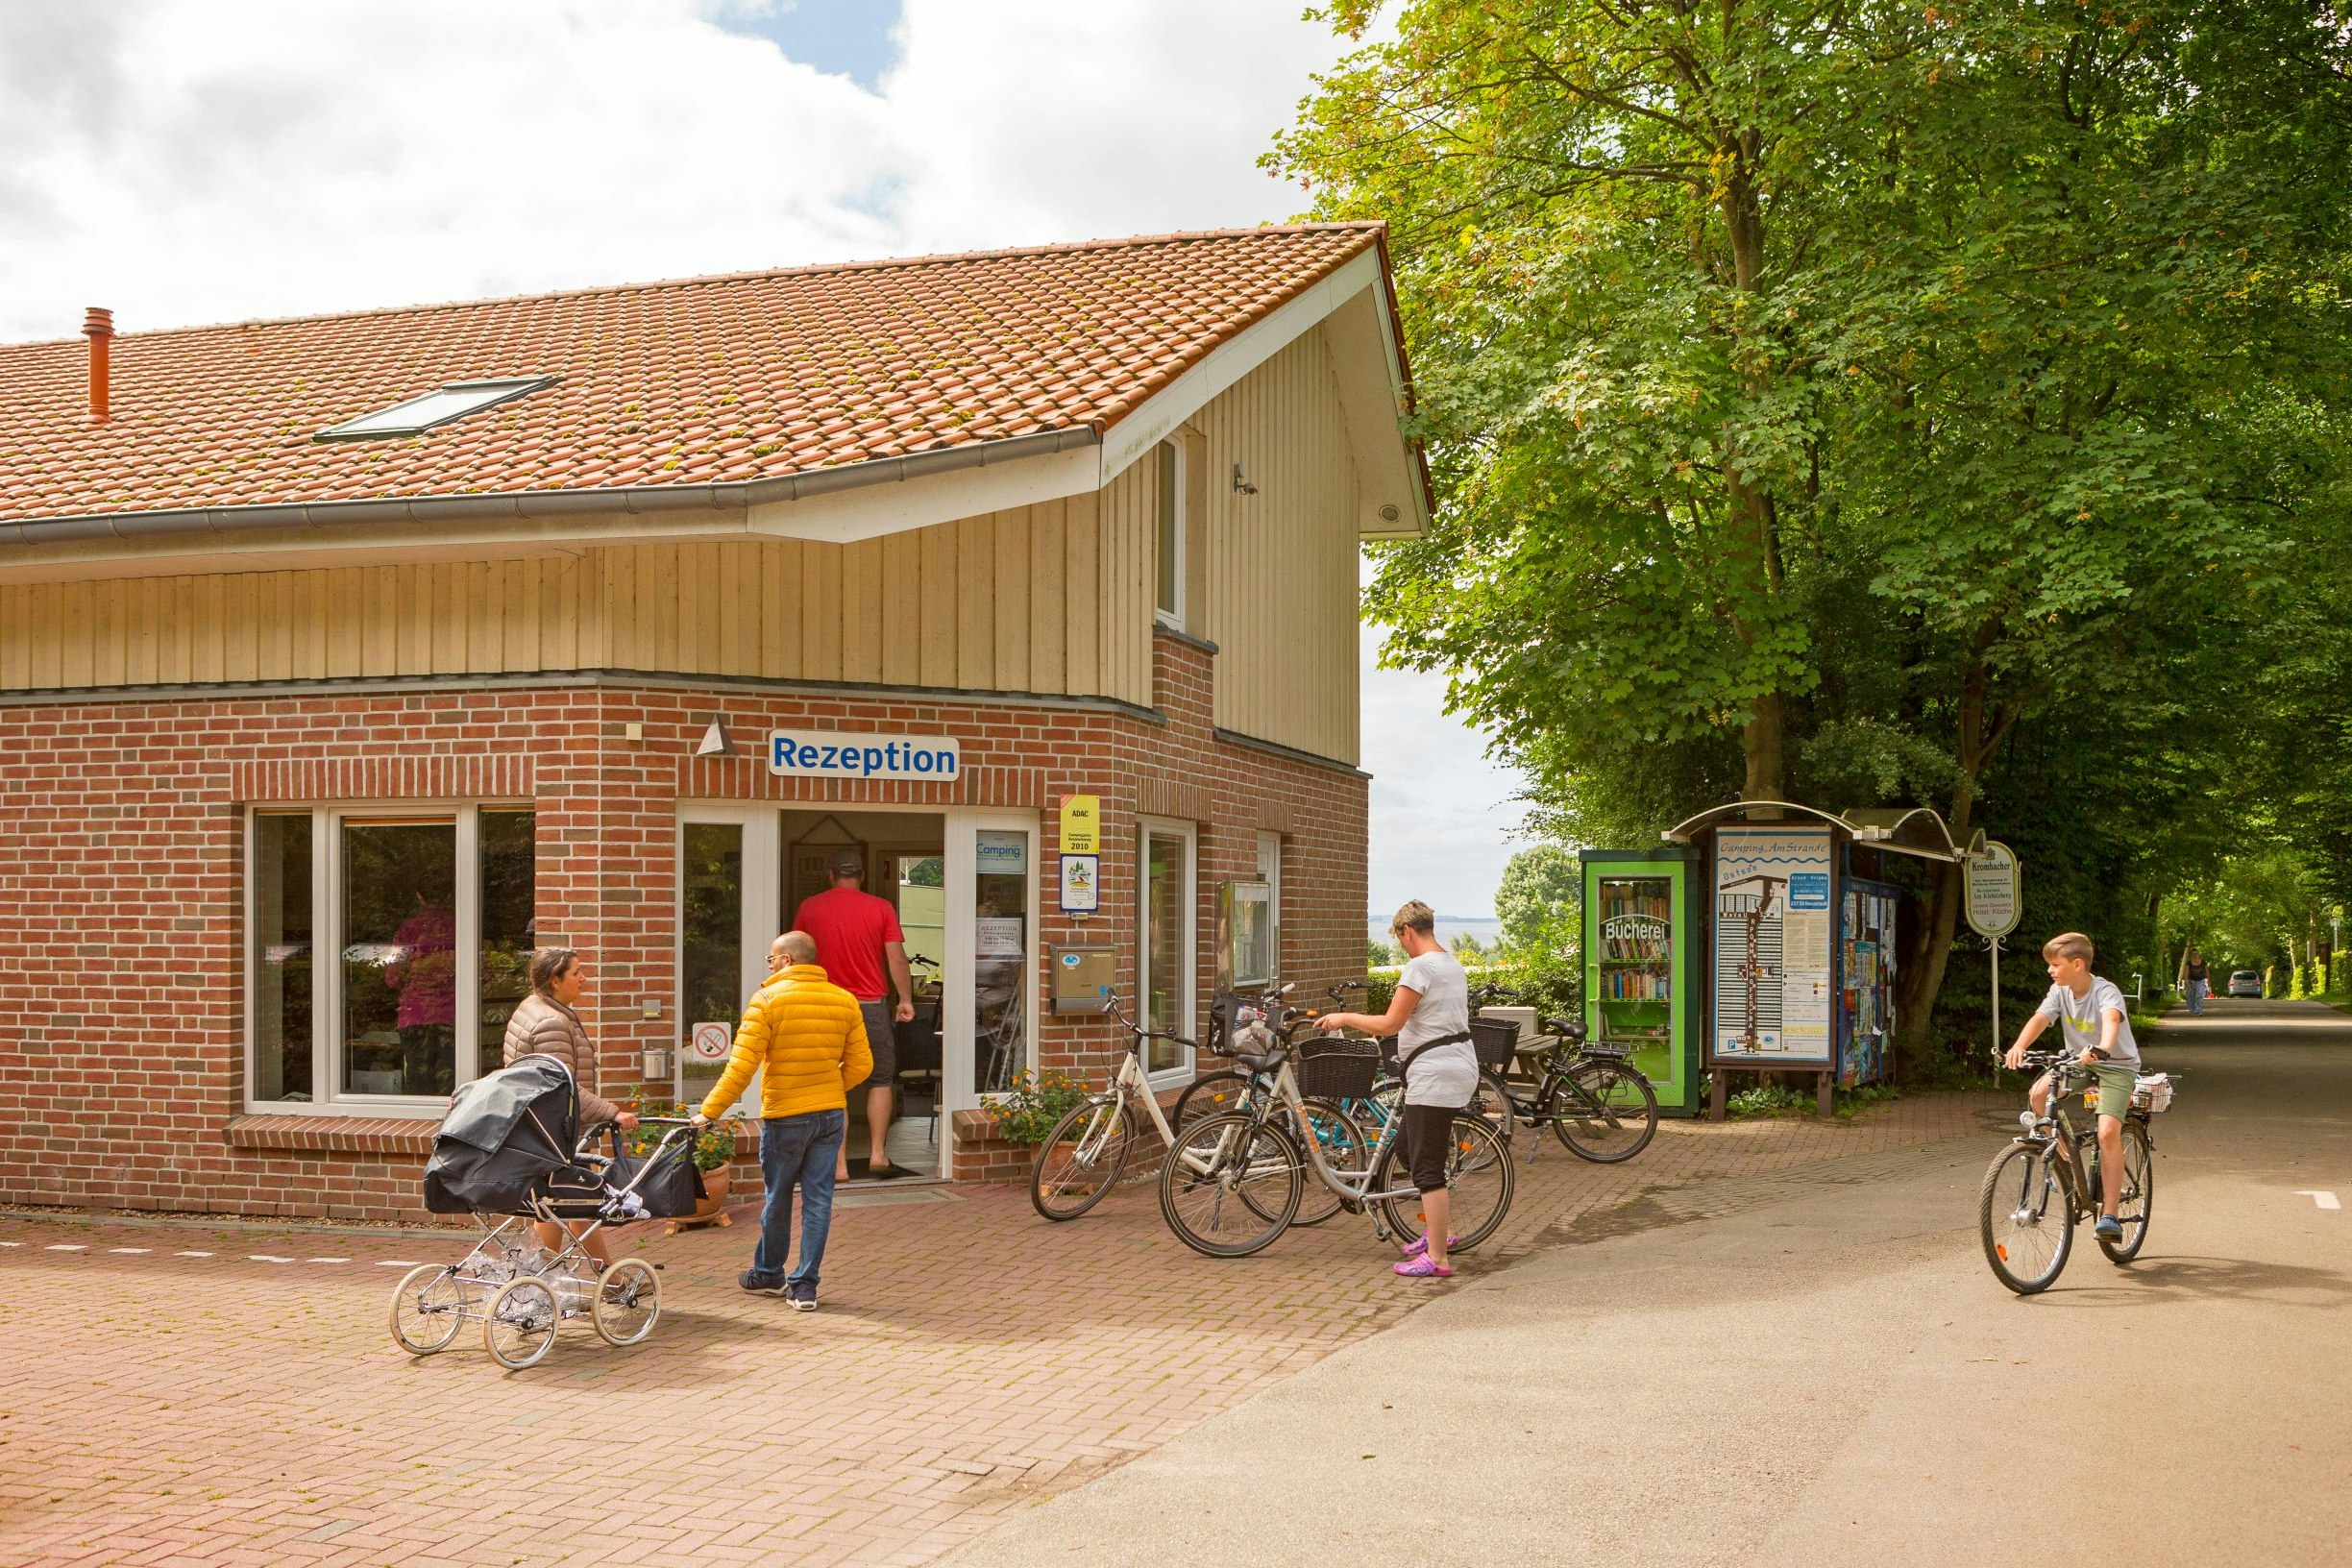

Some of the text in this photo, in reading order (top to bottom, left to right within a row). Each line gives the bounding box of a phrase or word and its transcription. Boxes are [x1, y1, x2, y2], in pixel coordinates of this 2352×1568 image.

[774, 737, 955, 777] Rezeption
[976, 843, 1020, 858] Camping
[1720, 842, 1764, 854] Camping
[1723, 865, 1757, 881] Ostsee
[1972, 861, 2010, 871] Krombacher
[1606, 919, 1665, 939] Bücherei
